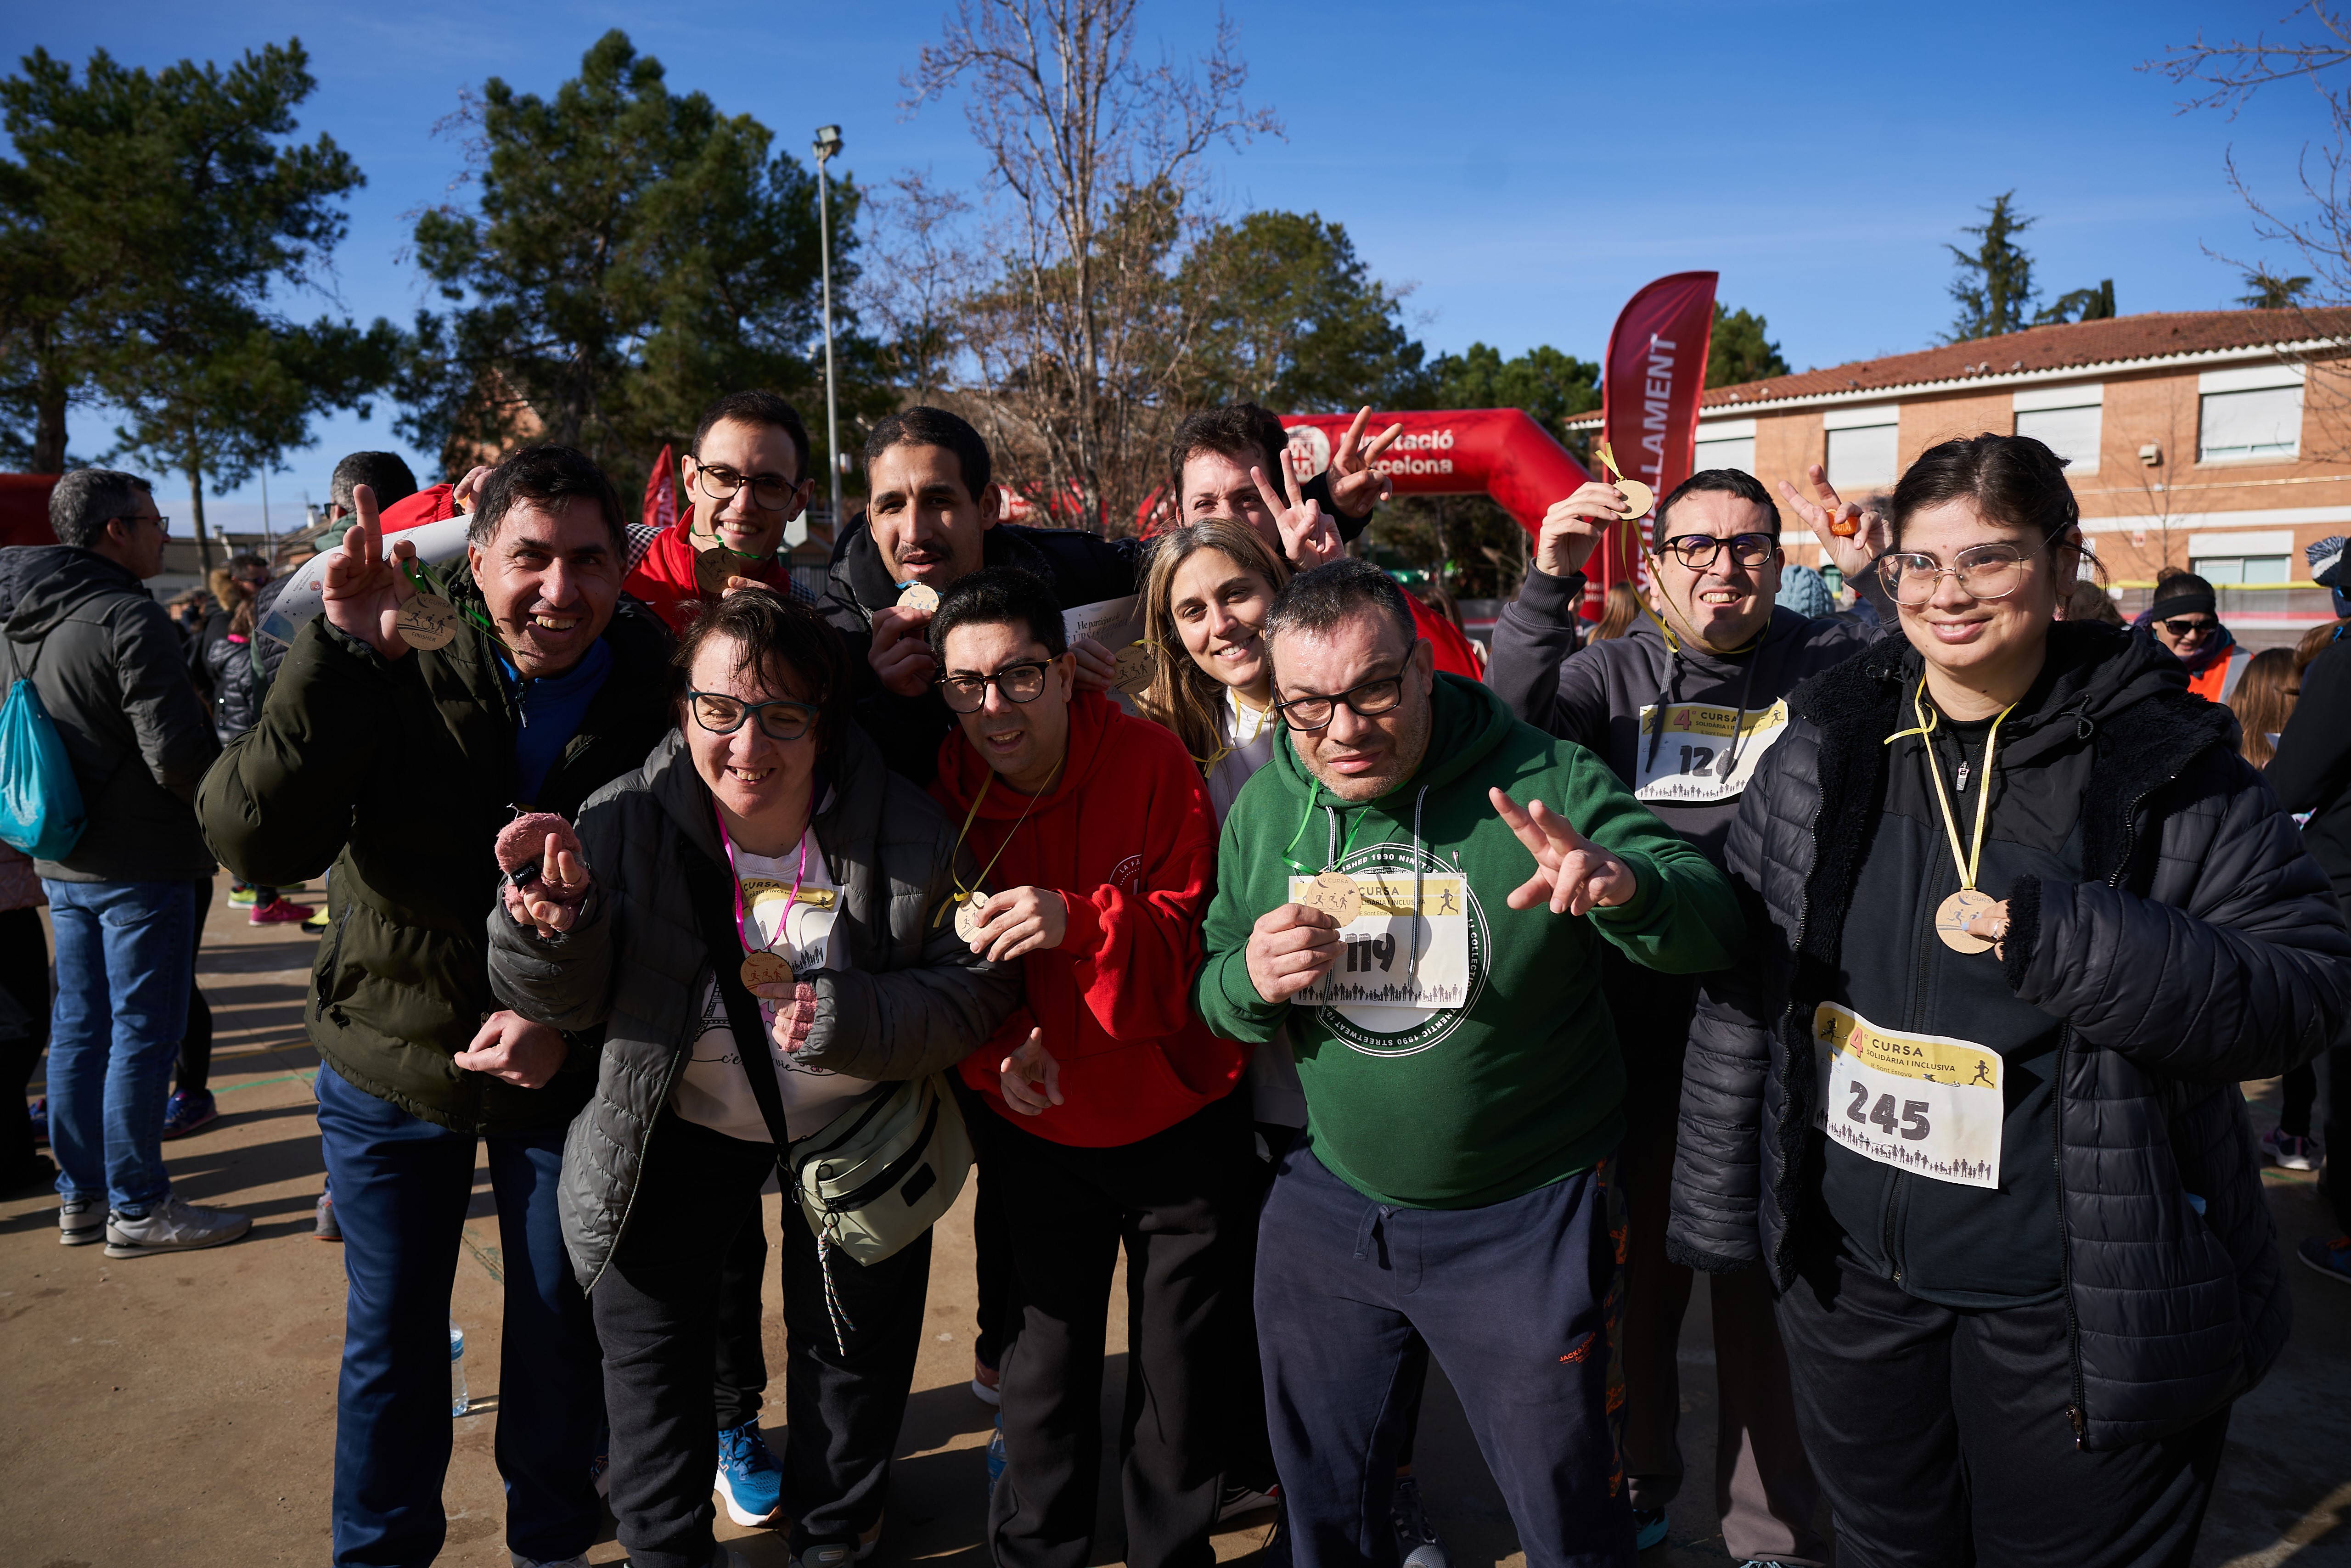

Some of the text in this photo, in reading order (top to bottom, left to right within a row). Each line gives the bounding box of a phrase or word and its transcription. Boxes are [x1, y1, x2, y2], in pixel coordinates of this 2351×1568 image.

[429, 599, 450, 609] CURSA
[1077, 621, 1088, 630] He
[411, 632, 436, 642] FINISHER
[1124, 649, 1142, 657] CURSA
[1128, 680, 1147, 688] FINISHER
[1700, 712, 1738, 723] CURSA
[1695, 720, 1726, 729] SOLIDÀRIA
[515, 866, 535, 879] SHIPS
[1119, 865, 1129, 873] LA
[743, 881, 781, 892] CURSA
[1359, 886, 1400, 896] CURSA
[1971, 895, 1997, 905] CURSA
[1345, 933, 1396, 972] 119
[1468, 932, 1479, 991] COLLECTIO
[1421, 1008, 1457, 1038] THENTIC
[1397, 1034, 1419, 1045] 1990
[1872, 1039, 1923, 1057] CURSA
[1867, 1049, 1904, 1065] SOLIDÀRIA
[1912, 1061, 1956, 1071] INCLUSIVA
[1891, 1069, 1912, 1077] Esteve
[1846, 1080, 1930, 1141] 245
